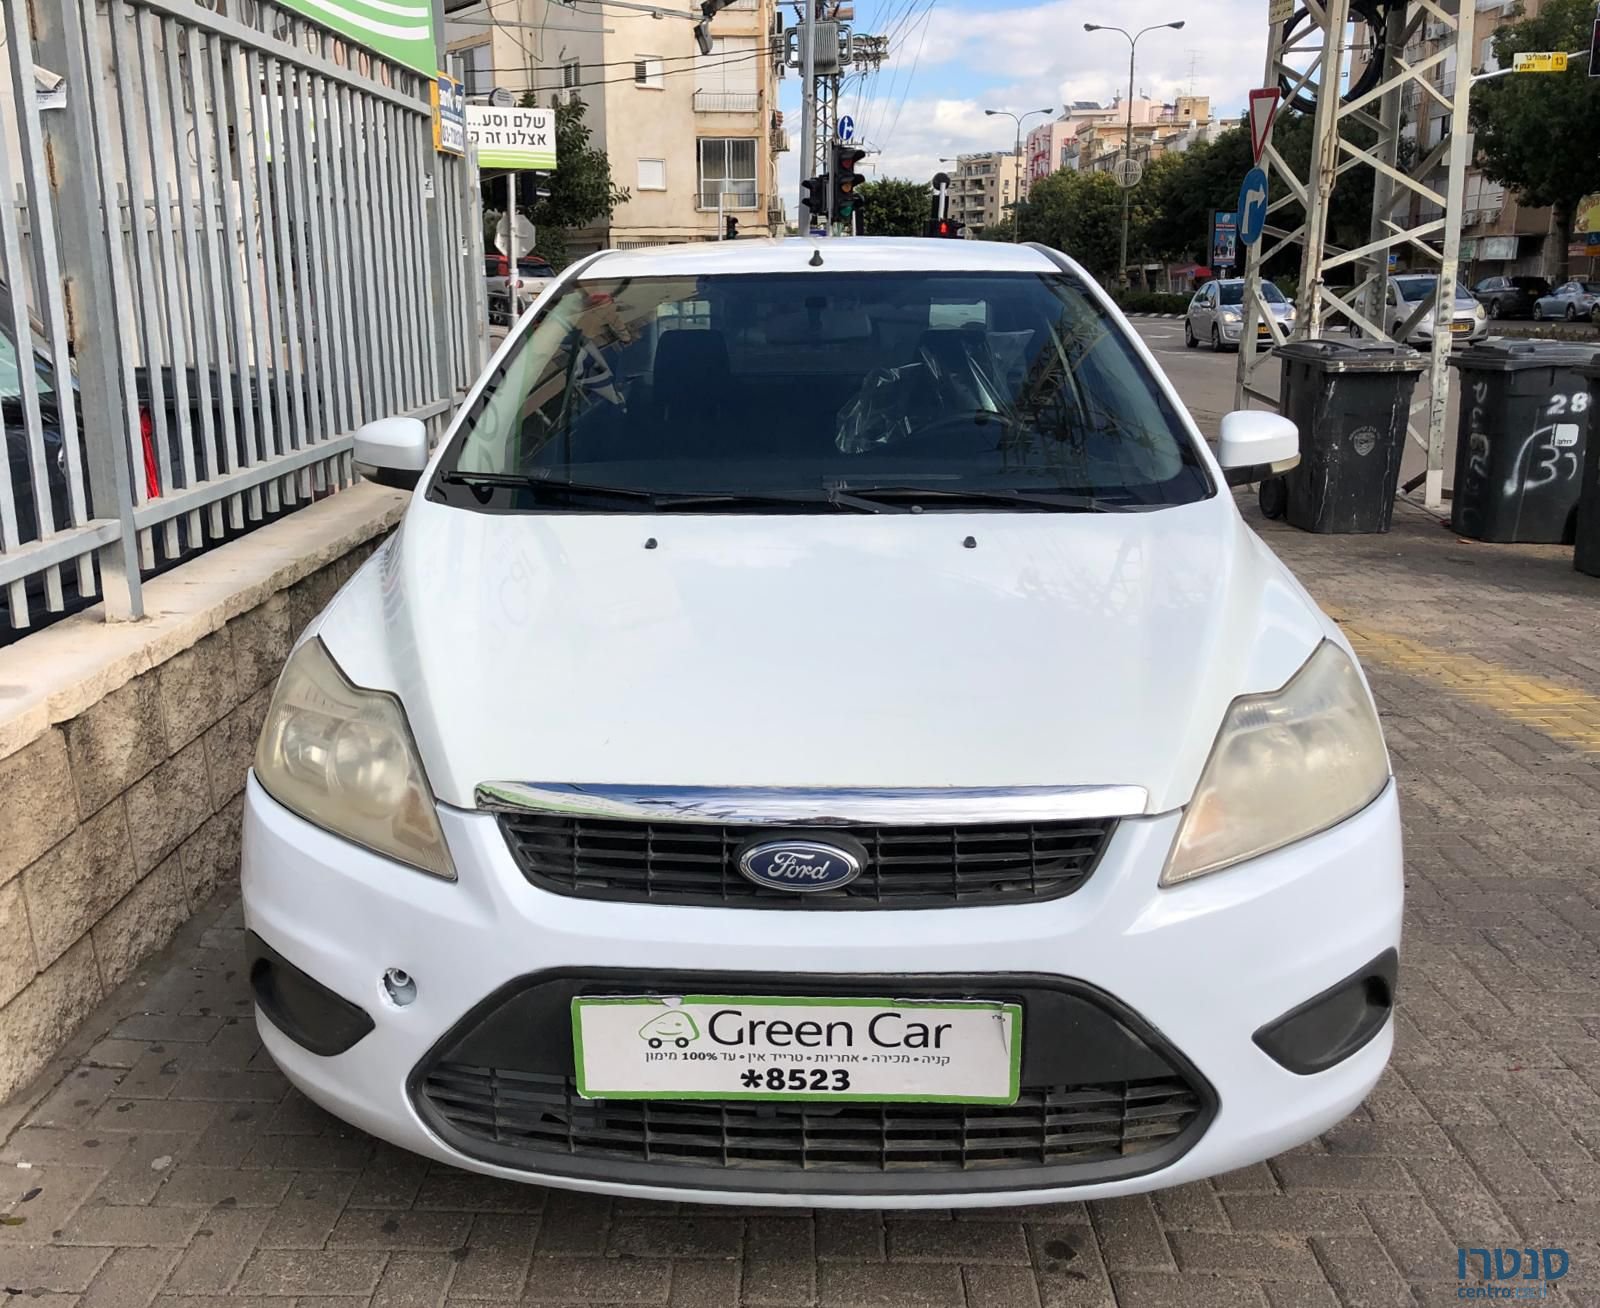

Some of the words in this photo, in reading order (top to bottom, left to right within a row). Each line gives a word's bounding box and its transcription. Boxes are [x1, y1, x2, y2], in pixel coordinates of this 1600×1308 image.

[1555, 56, 1564, 65] 13
[467, 114, 508, 127] וסע...
[514, 112, 546, 129] שלם
[486, 131, 502, 144] זה
[506, 130, 546, 146] אצלנו
[1546, 392, 1591, 416] 28
[767, 851, 831, 880] Ford
[708, 1009, 853, 1048] Green
[868, 1012, 952, 1049] Car
[645, 1051, 678, 1064] מימון
[681, 1051, 718, 1062] 100%
[719, 1052, 736, 1061] עד
[748, 1052, 767, 1064] אין
[769, 1052, 804, 1063] טרייד
[814, 1053, 860, 1064] אחריות
[871, 1054, 910, 1064] מכירה
[921, 1055, 951, 1067] קניה
